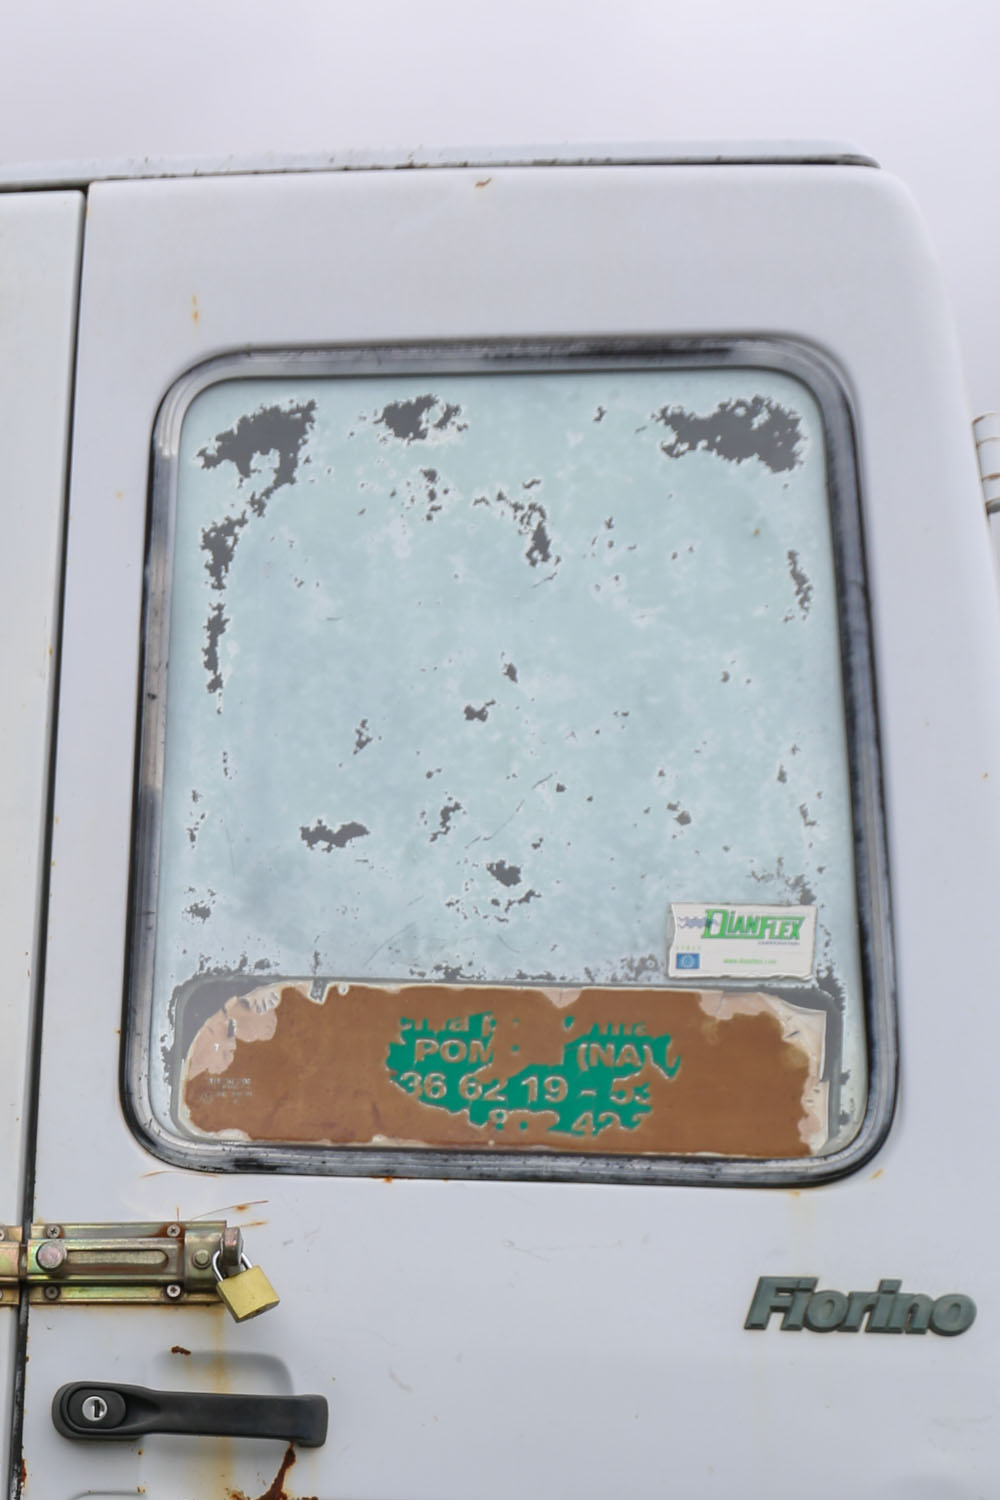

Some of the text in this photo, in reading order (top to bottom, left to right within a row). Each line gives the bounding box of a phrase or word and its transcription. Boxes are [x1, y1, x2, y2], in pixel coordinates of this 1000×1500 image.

[459, 1073, 508, 1100] 62
[521, 1075, 569, 1103] 19
[743, 1275, 977, 1337] Fiorino
